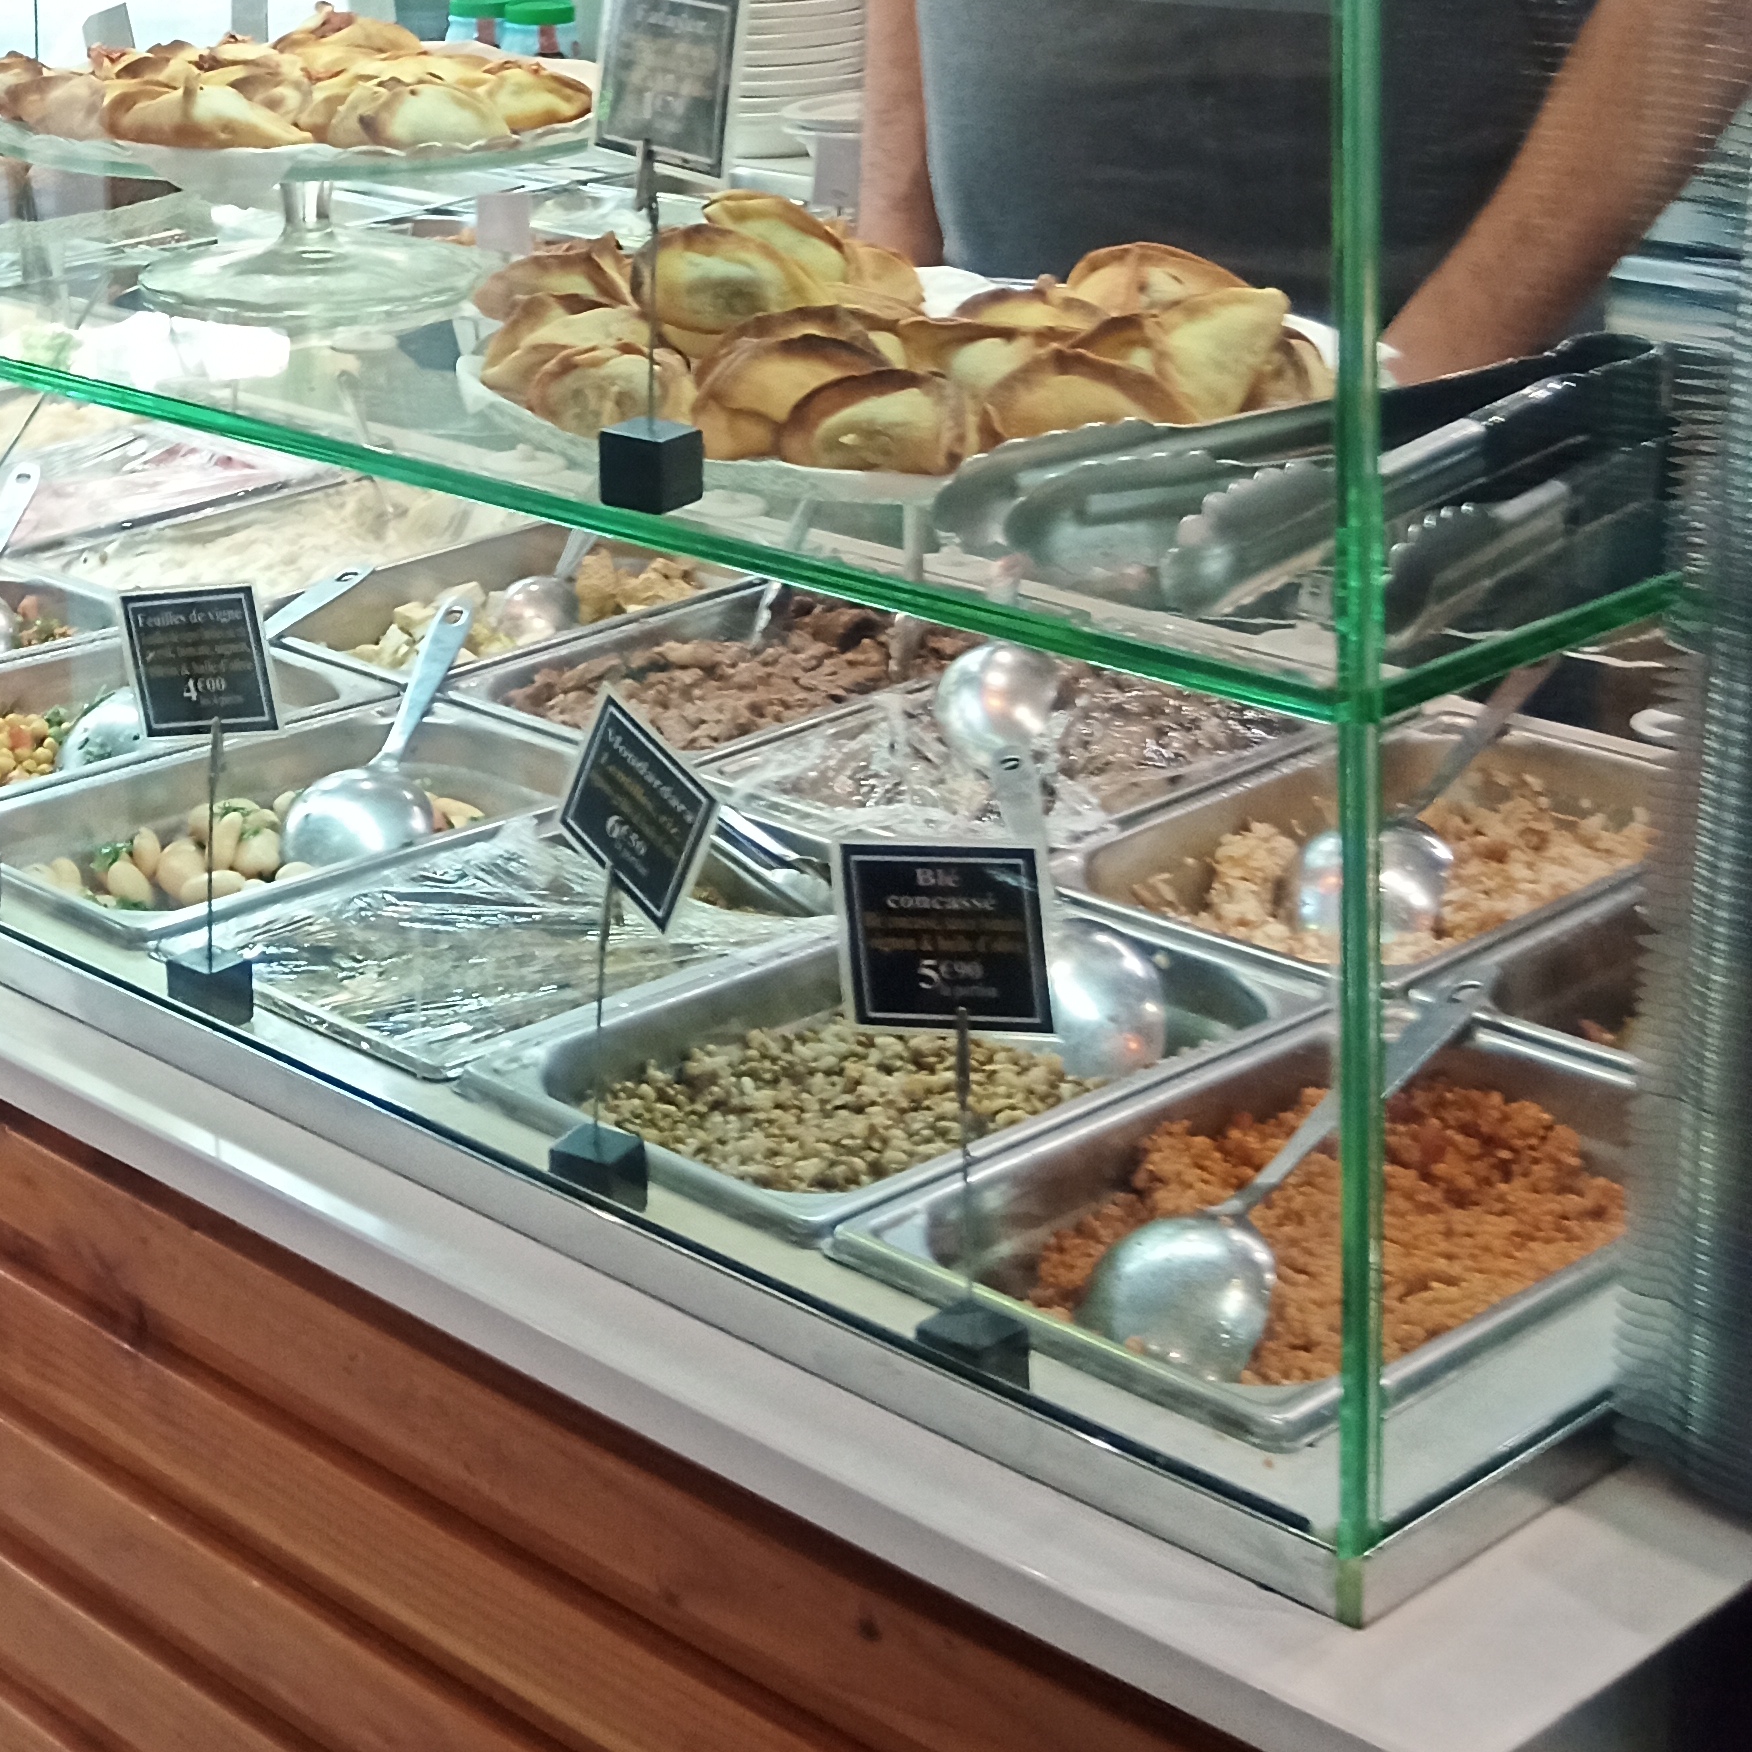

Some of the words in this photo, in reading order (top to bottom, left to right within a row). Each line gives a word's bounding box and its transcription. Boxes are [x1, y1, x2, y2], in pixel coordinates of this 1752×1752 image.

[137, 609, 186, 629] Feuilles
[188, 607, 205, 624] de
[208, 606, 243, 624] vigne
[915, 867, 961, 888] Blé
[886, 893, 997, 911] concassé
